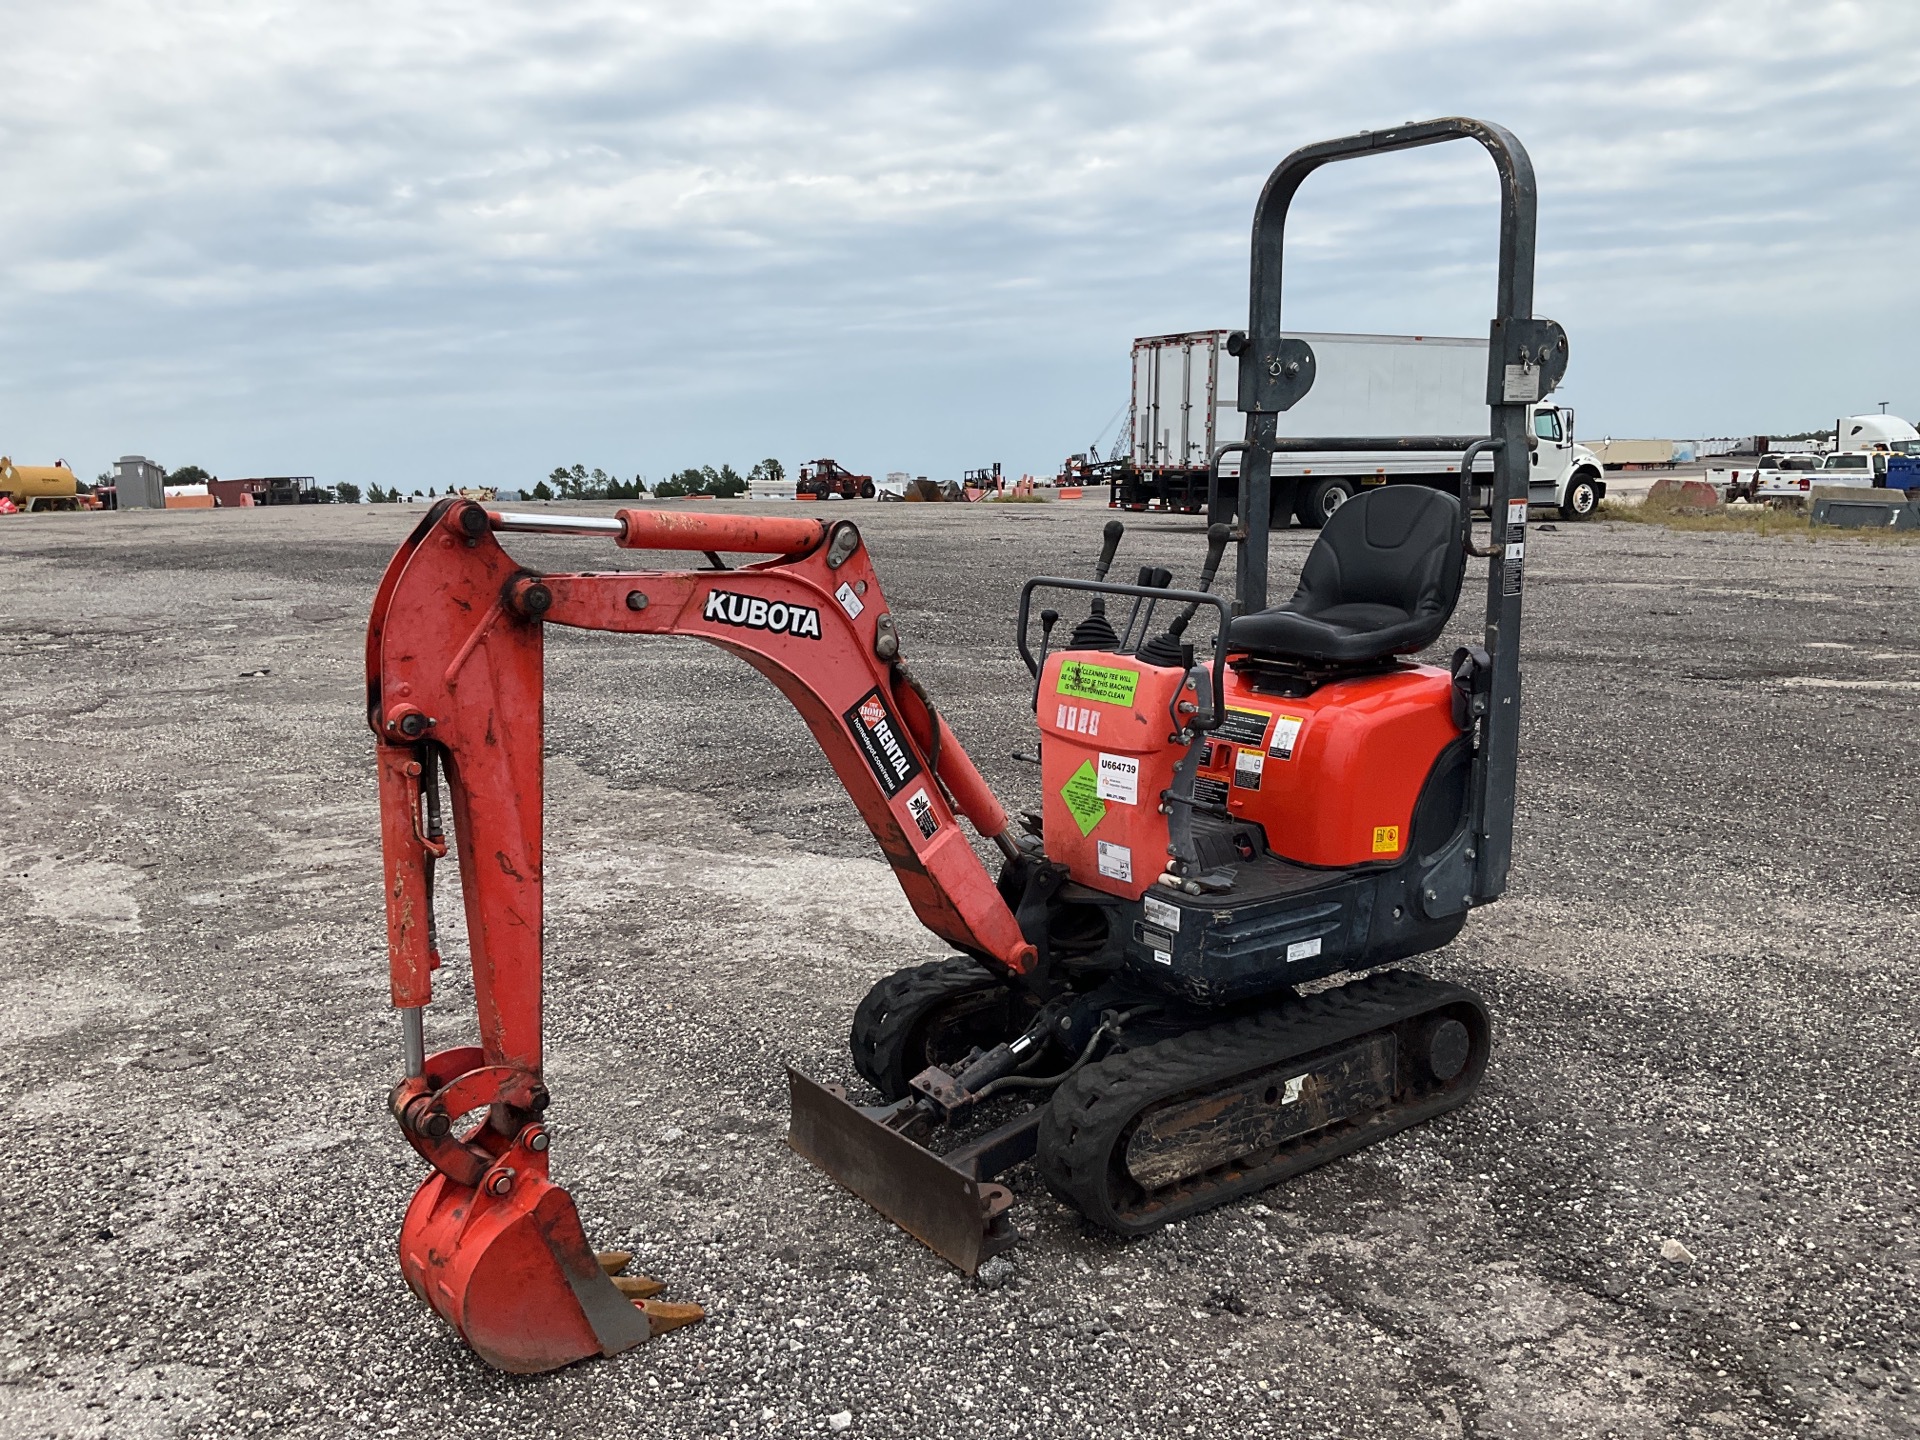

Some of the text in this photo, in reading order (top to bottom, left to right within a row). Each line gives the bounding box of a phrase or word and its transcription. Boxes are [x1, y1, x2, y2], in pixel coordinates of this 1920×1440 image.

[705, 590, 820, 637] KUBOTA
[1082, 668, 1108, 679] CLEANING
[1080, 685, 1107, 696] RETURNED
[1107, 690, 1126, 700] CLEAN
[1097, 680, 1108, 688] THIS
[1109, 682, 1134, 692] MACHINE
[860, 706, 884, 717] HOME
[853, 717, 896, 790] homedepot.com/rental
[873, 719, 910, 781] RENTAL
[1101, 759, 1137, 774] U664739
